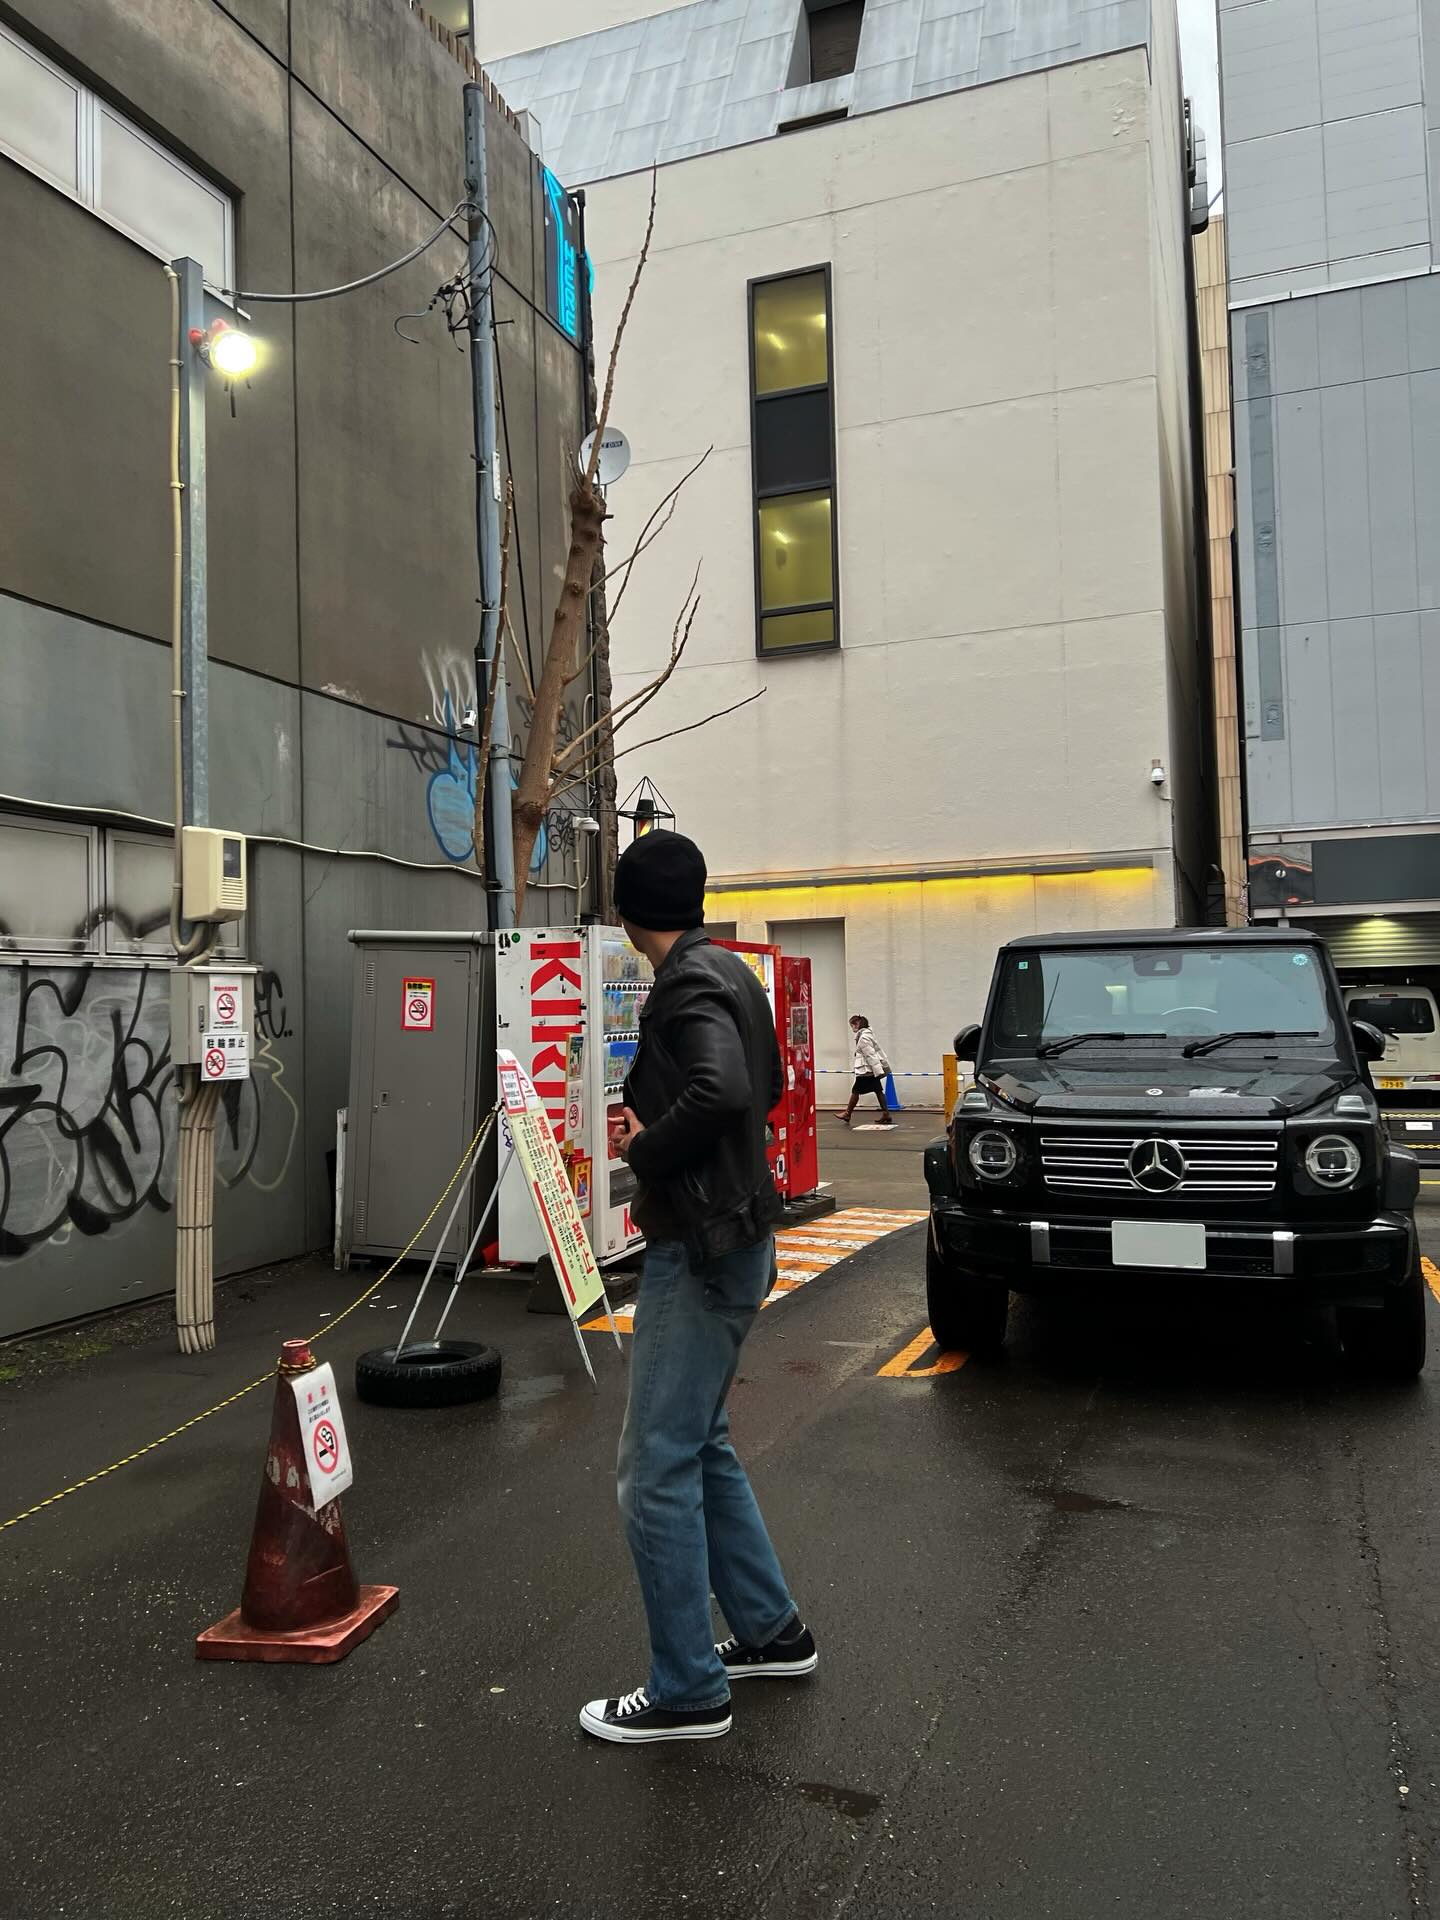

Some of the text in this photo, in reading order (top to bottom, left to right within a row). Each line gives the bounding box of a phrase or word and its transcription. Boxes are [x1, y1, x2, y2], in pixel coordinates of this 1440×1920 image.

[536, 1115, 595, 1275] 通り抜け禁止
